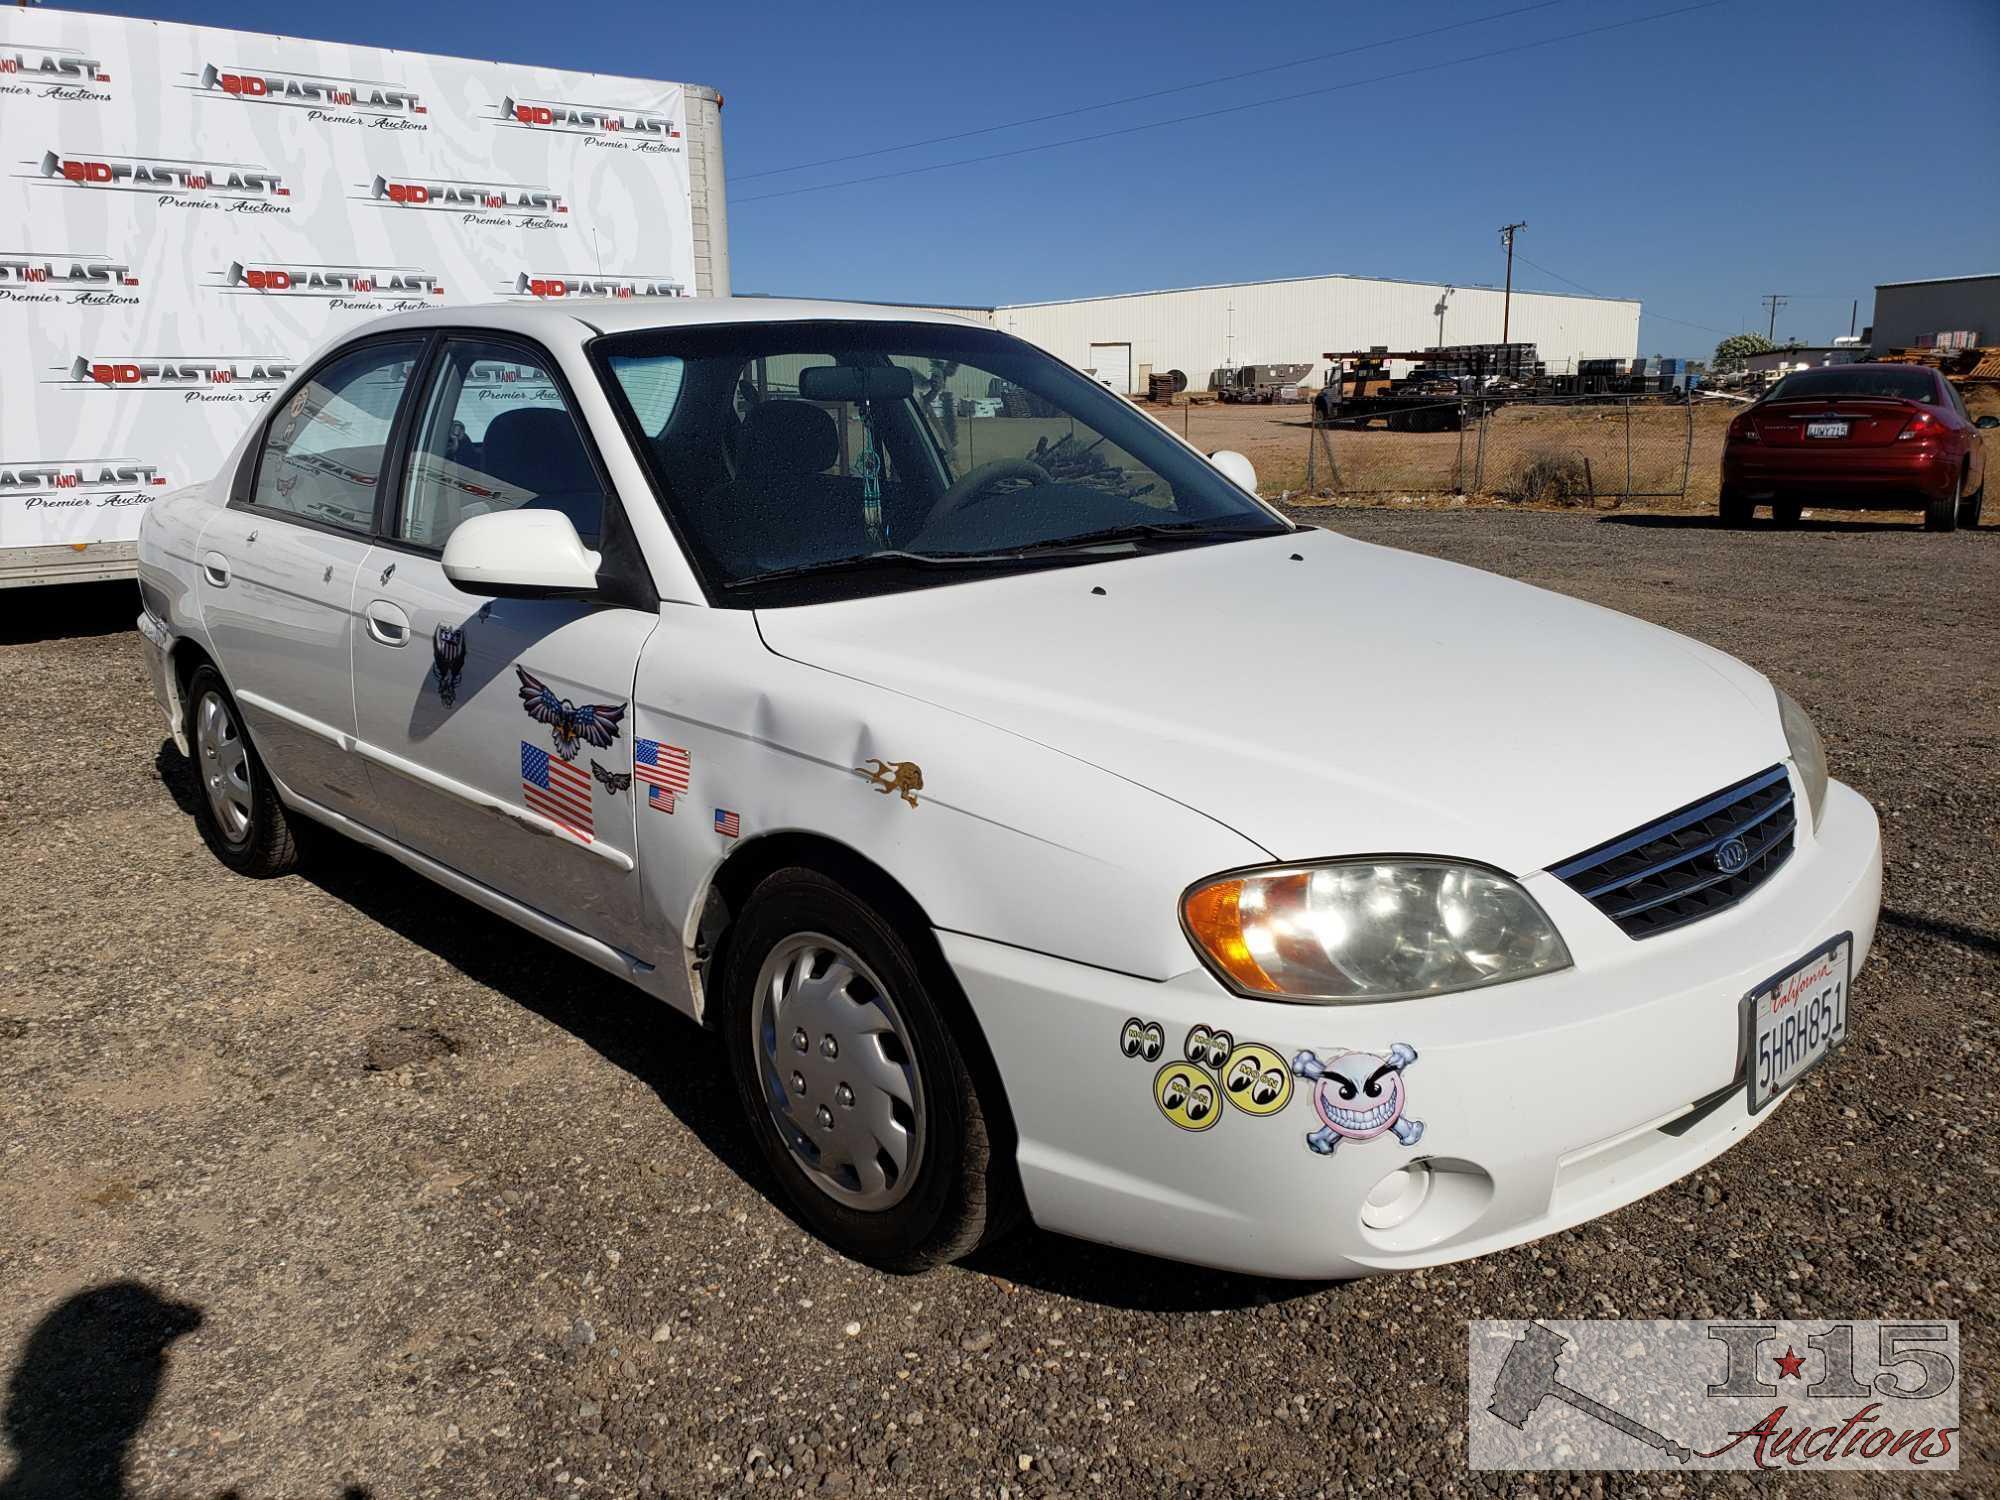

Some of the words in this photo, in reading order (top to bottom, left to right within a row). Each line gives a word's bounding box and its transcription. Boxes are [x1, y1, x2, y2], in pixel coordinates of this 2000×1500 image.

[37, 87, 111, 101] Auctions
[307, 110, 364, 126] Premier
[368, 117, 428, 131] Auctions
[517, 105, 681, 138] BIDFASTANDLAST.
[584, 137, 628, 149] Premier
[632, 142, 681, 153] Auctions
[158, 195, 221, 210] Premier
[225, 200, 291, 214] Auctions
[463, 214, 512, 225] Premier
[515, 217, 569, 229] Auctions
[247, 271, 444, 295] BIDFASTANDLAST.
[67, 292, 140, 305] Auctions
[329, 299, 383, 310] Premier
[184, 391, 243, 403] Premier
[479, 390, 526, 400] Premier
[25, 497, 92, 510] Premier
[1128, 1028, 1158, 1043] MOON
[1194, 1034, 1226, 1051] MOON
[1759, 982, 1842, 1087] 5HRH851
[1239, 1063, 1279, 1089] MOON
[1171, 1081, 1209, 1105] MOON
